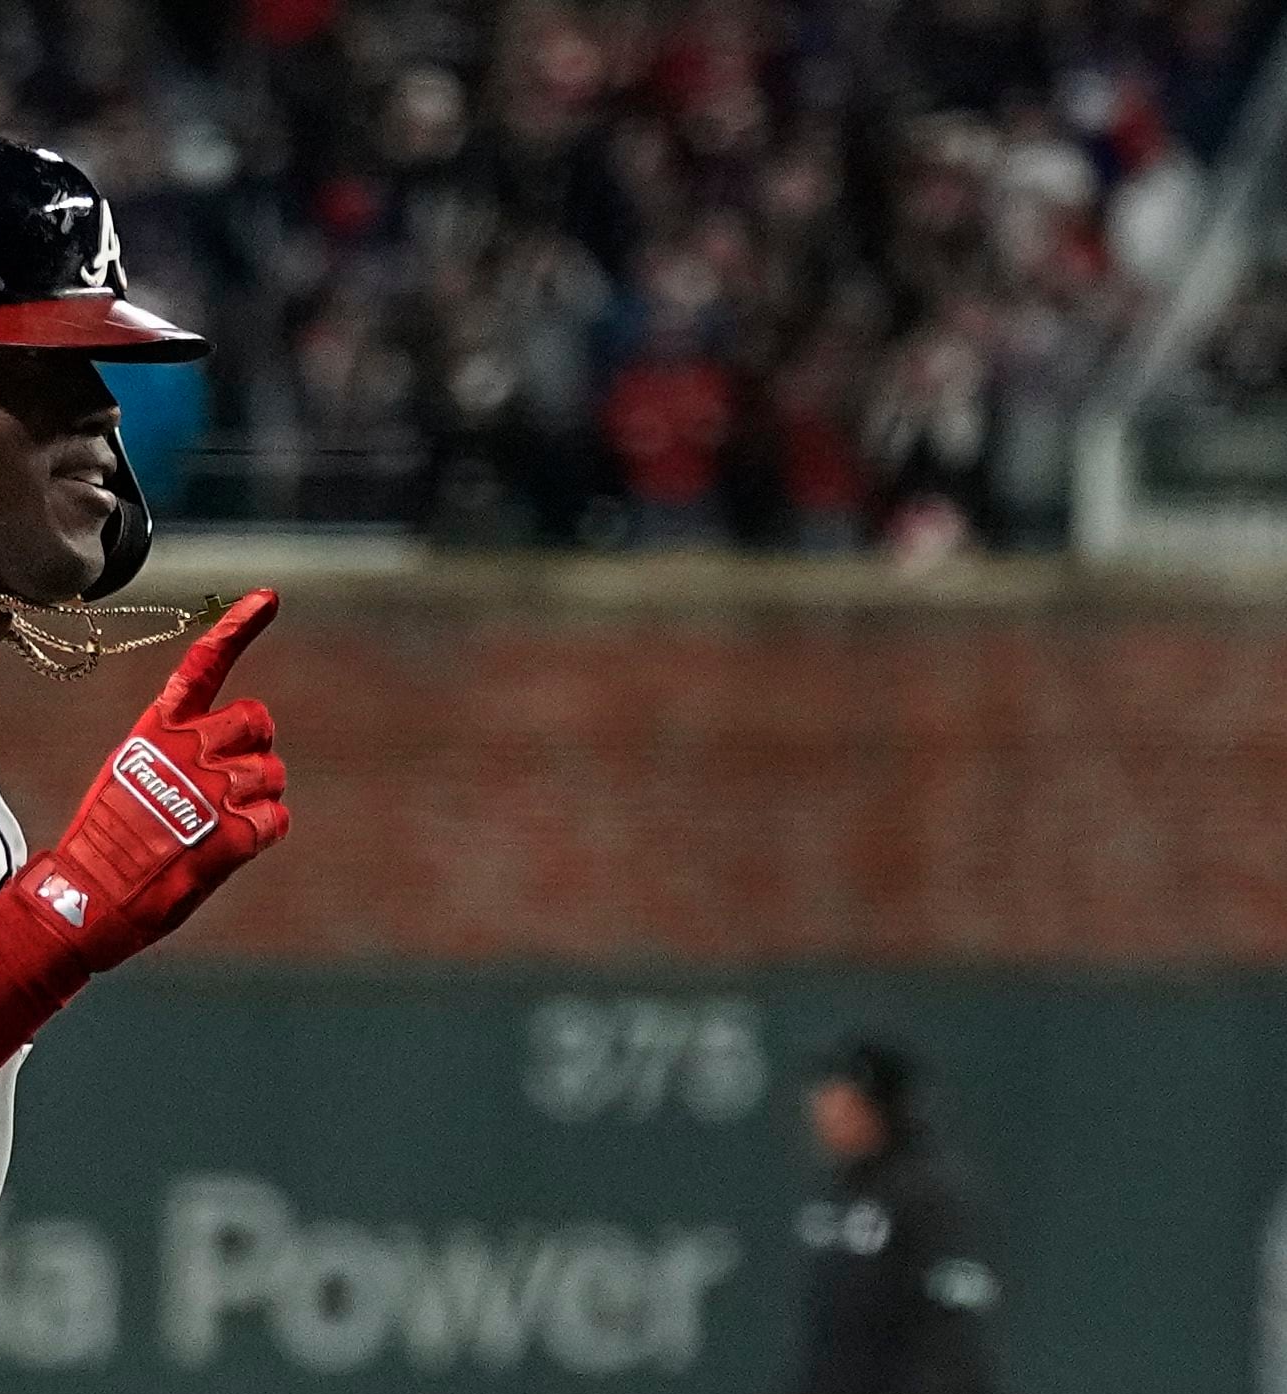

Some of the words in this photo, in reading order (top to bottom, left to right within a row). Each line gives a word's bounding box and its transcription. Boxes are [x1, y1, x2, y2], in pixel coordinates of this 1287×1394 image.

[80, 198, 128, 290] A
[119, 743, 203, 830] Franklin
[163, 1175, 737, 1372] Power
